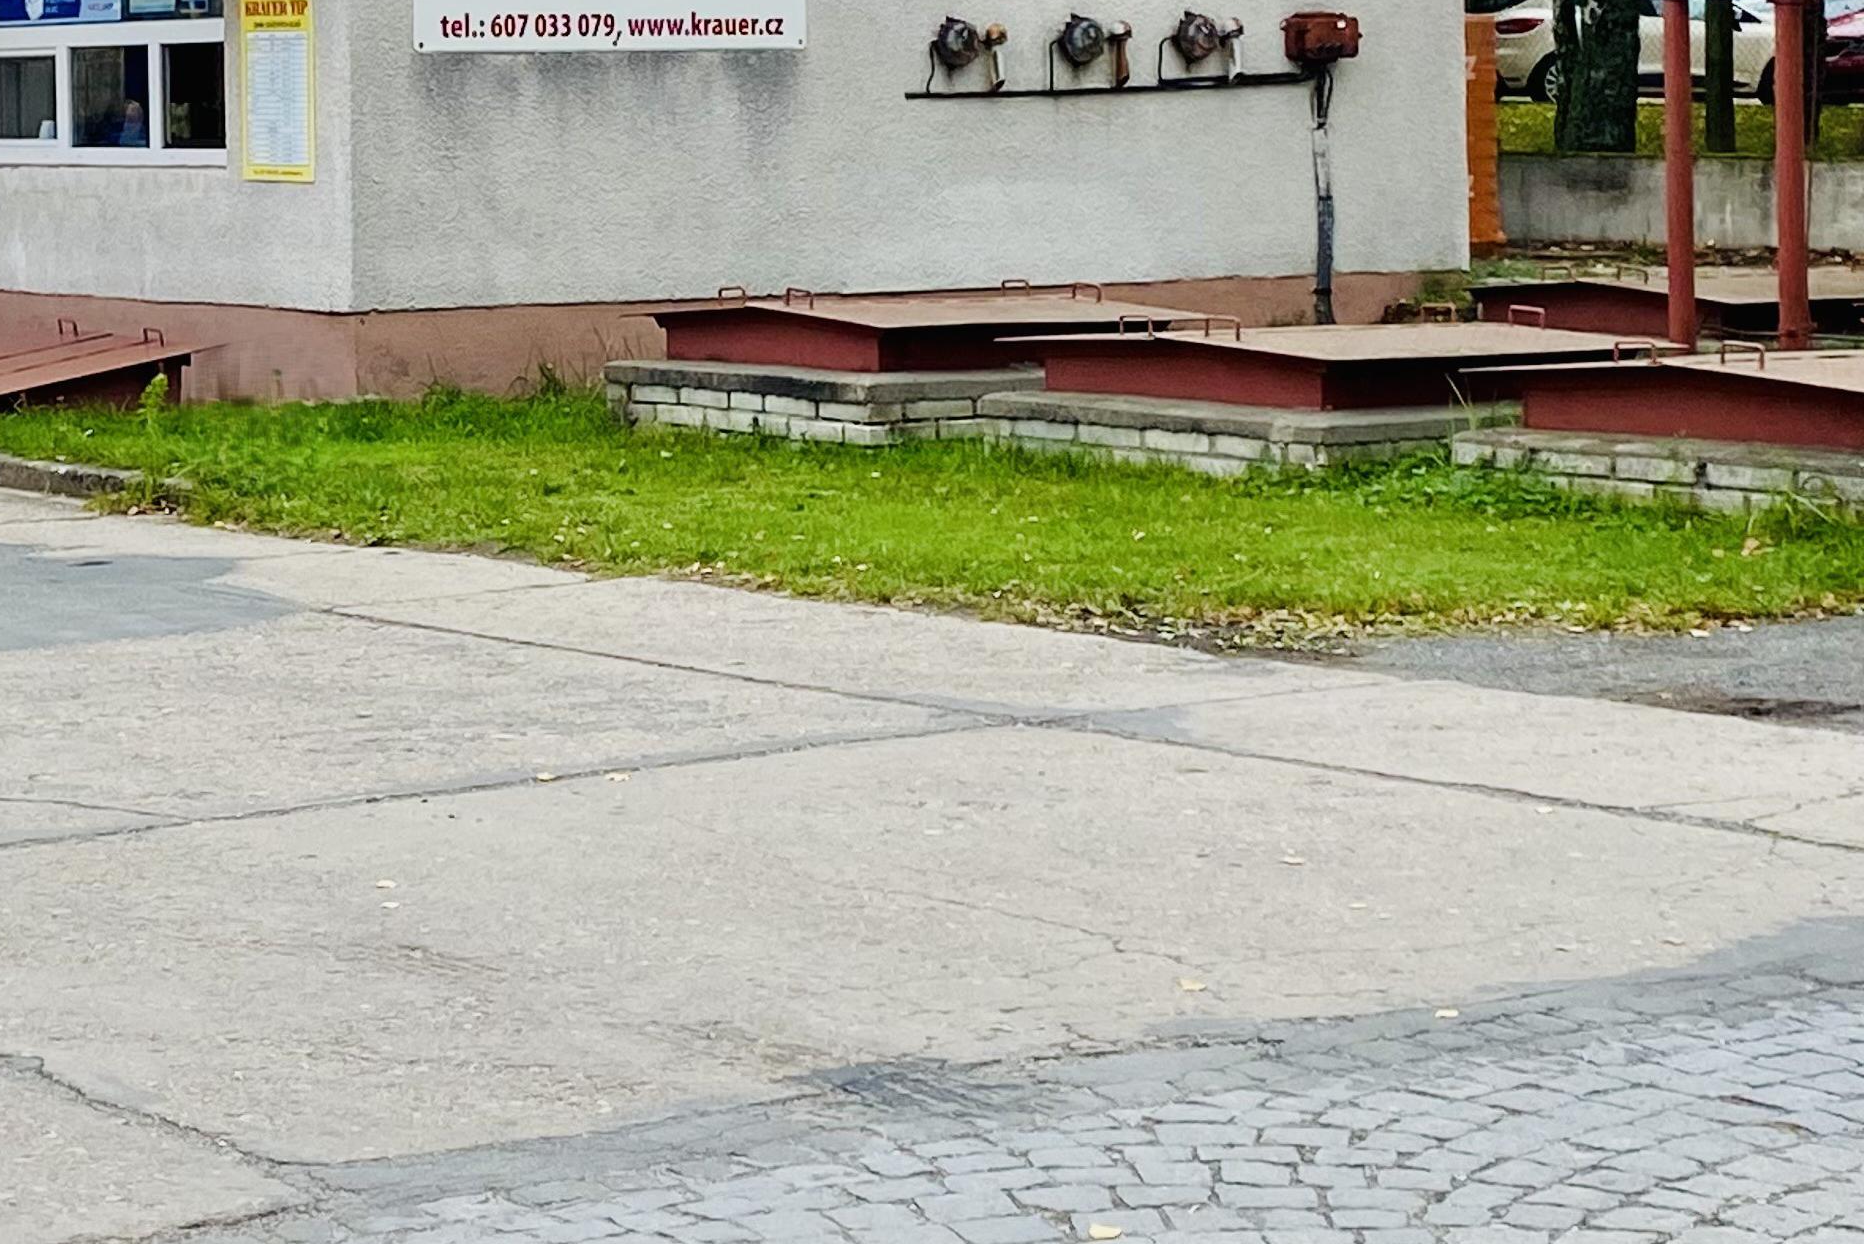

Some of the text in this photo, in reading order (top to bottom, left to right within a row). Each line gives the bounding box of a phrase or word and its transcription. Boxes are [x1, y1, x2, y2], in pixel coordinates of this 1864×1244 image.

[440, 13, 485, 38] tel.:
[491, 14, 529, 37] 607
[535, 14, 572, 37] 033
[628, 11, 784, 37] www.krauer.cz
